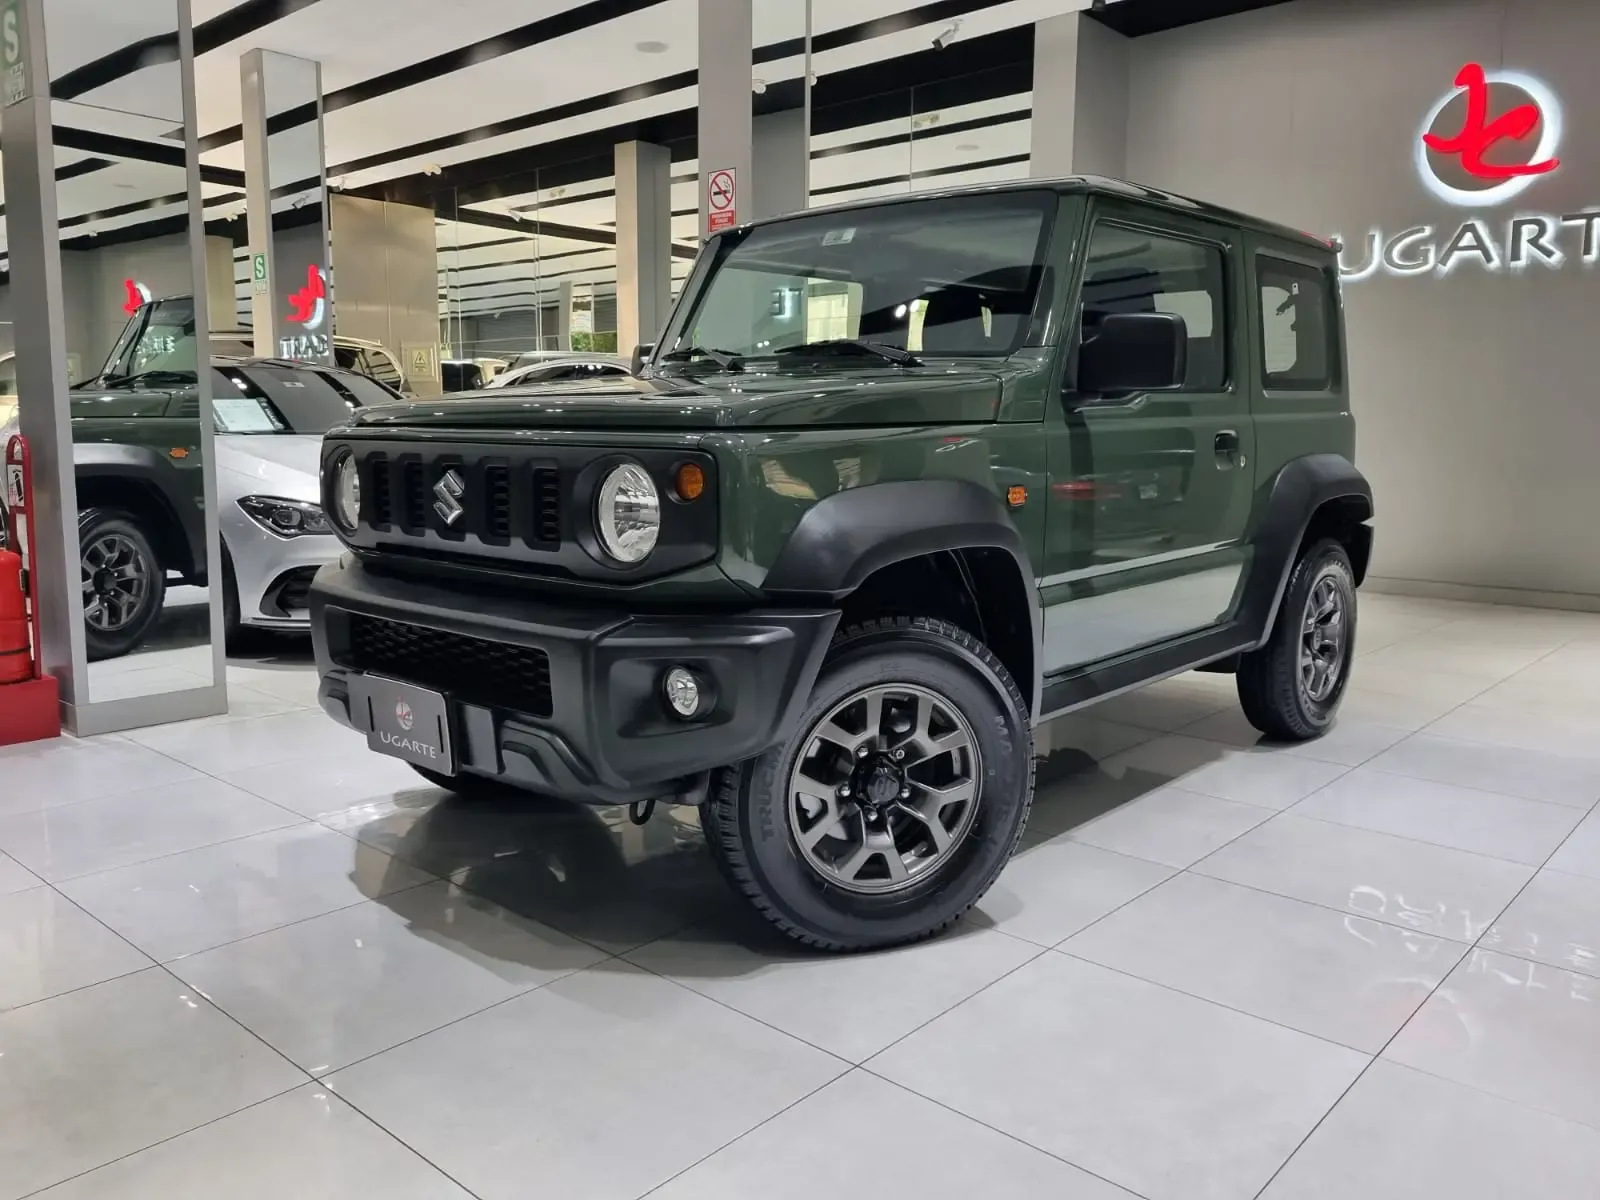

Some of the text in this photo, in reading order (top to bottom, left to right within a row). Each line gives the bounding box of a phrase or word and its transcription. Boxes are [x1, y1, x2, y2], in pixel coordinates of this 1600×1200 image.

[4, 10, 19, 63] S
[255, 256, 265, 278] S
[380, 731, 437, 759] UGARTE
